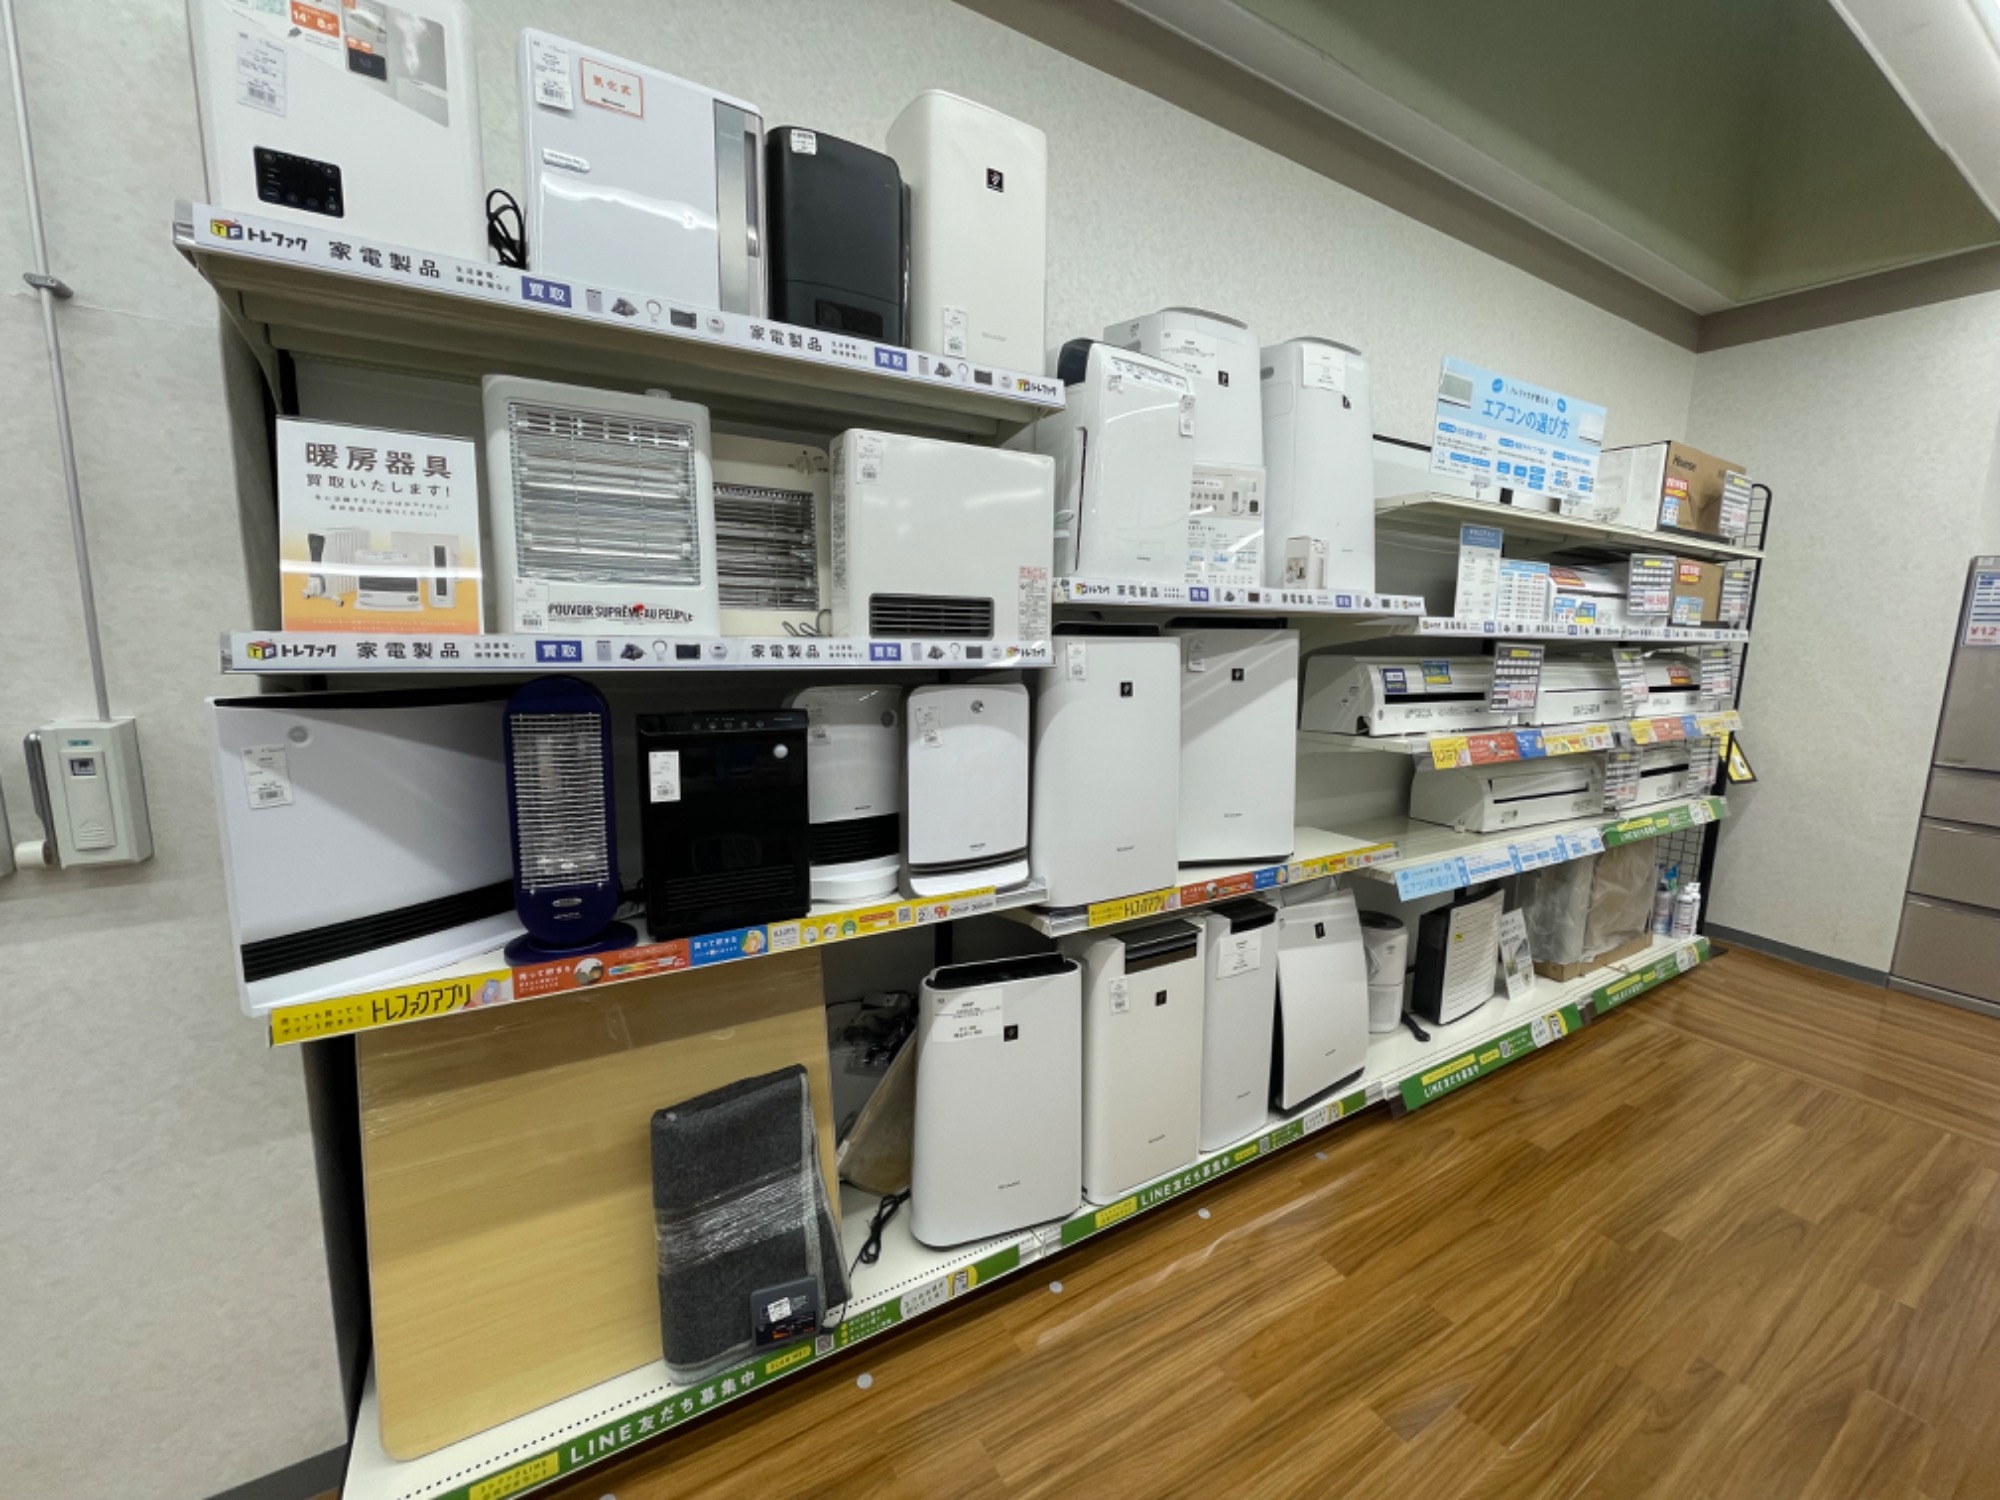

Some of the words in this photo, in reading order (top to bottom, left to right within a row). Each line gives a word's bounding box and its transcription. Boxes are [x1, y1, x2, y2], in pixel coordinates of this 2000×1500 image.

[247, 228, 307, 251] トレファク
[329, 240, 440, 279] 家電製品
[529, 281, 566, 303] 買取
[749, 324, 822, 353] 家電製品
[879, 352, 904, 369] 買取
[1482, 398, 1569, 440] エアコンの選び方
[305, 441, 452, 480] 暖房器具
[306, 473, 451, 498] 買取いたします!
[549, 603, 593, 617] POUVOIR
[644, 607, 657, 620] AU
[281, 644, 337, 658] トレファク
[357, 642, 460, 659] 家電製品
[542, 643, 577, 659] 買取
[751, 644, 820, 659] 家電製品
[874, 645, 897, 659] 買取
[372, 983, 471, 1023] トレファクアプリ
[1141, 1156, 1230, 1206] LINE友だち募集中
[571, 1370, 755, 1464] LINE友だち募集中
